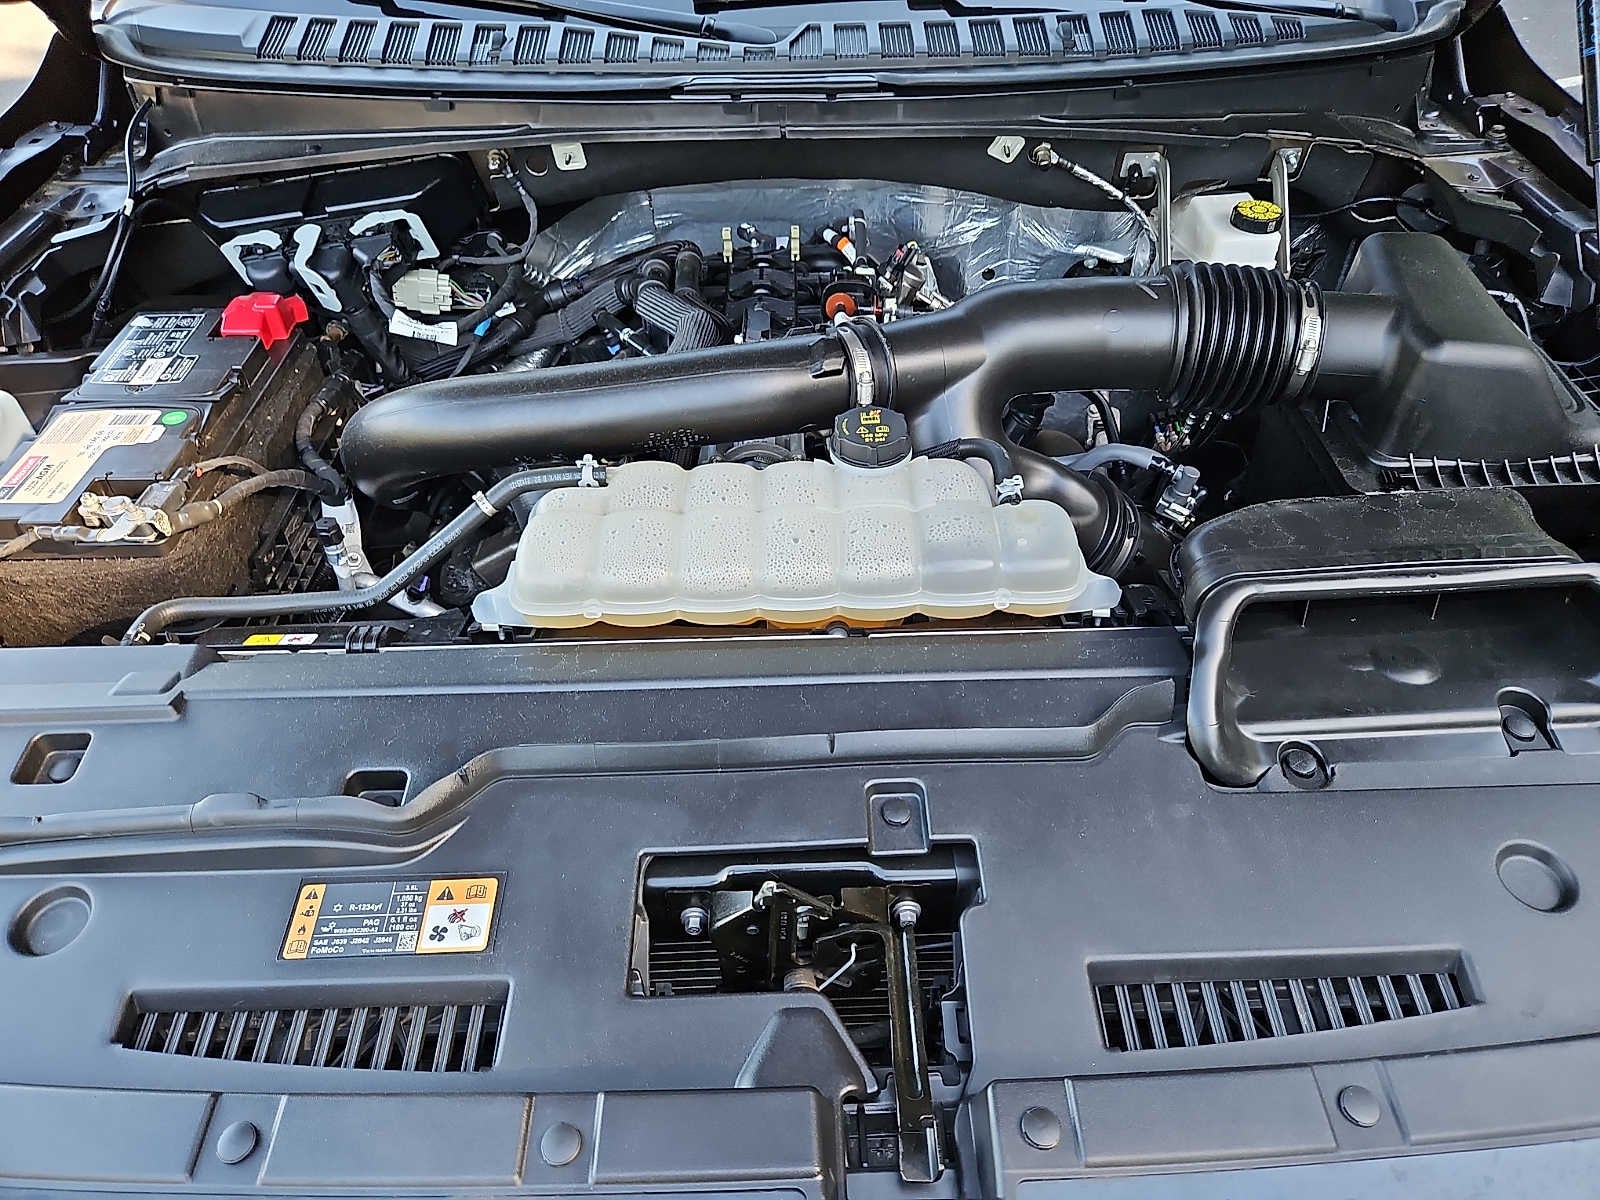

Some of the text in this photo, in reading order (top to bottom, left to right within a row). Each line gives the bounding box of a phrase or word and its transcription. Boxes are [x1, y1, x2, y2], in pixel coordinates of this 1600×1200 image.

[414, 894, 423, 903] kg
[349, 903, 383, 912] R-1234yf
[363, 919, 380, 927] PAG
[405, 923, 417, 931] cc)
[311, 946, 345, 955] FoMoCo
